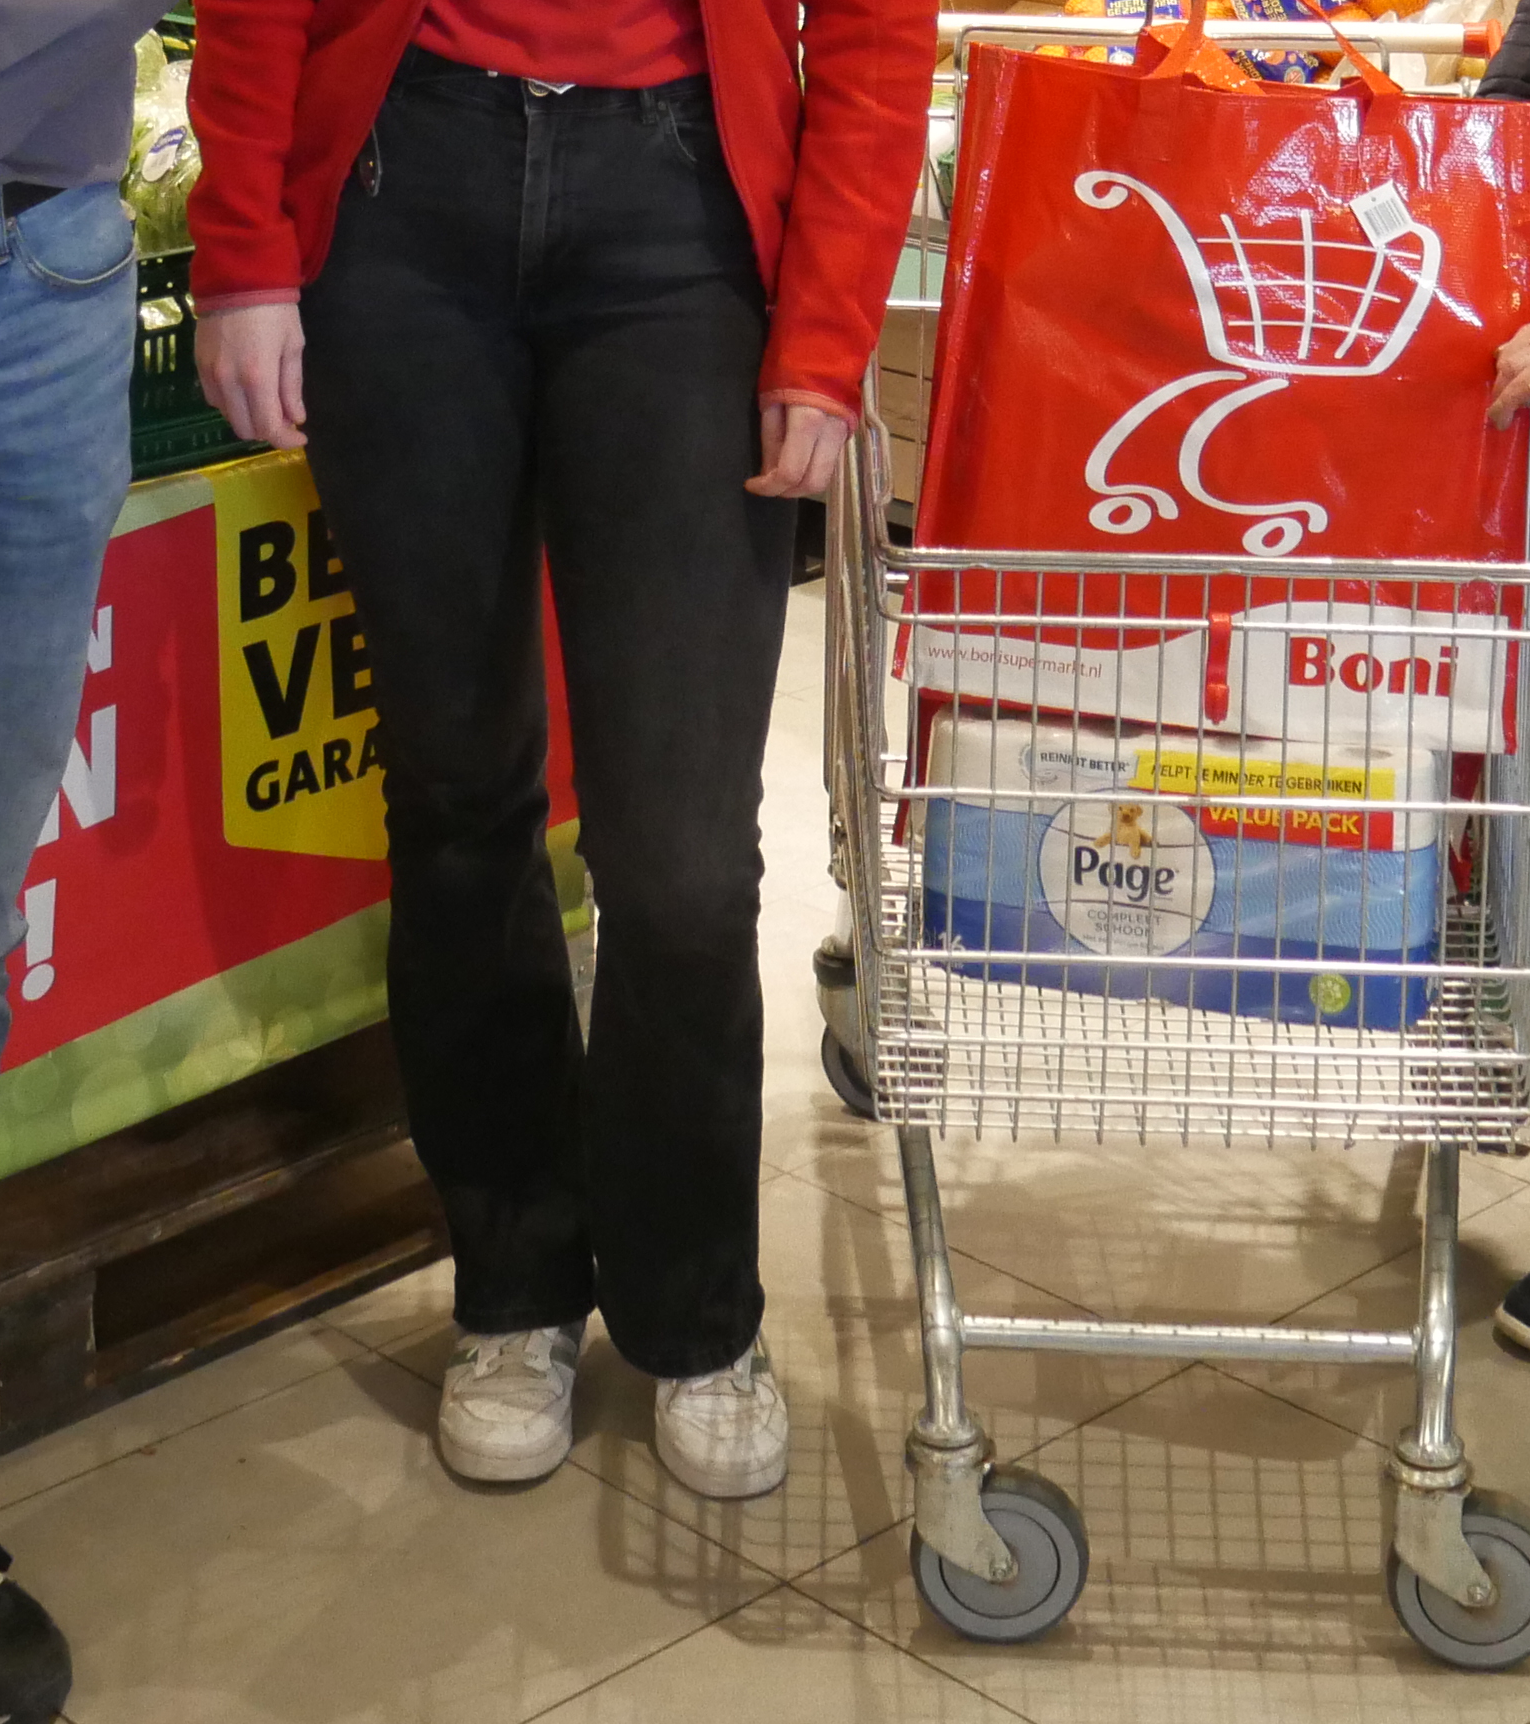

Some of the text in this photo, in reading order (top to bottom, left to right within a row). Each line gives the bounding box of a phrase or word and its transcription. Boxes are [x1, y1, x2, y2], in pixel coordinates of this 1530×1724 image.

[928, 645, 1103, 678] www.bonisupemarkt.nl
[1289, 636, 1459, 697] Boni
[1293, 809, 1360, 835] PACK
[1074, 846, 1175, 902] Page
